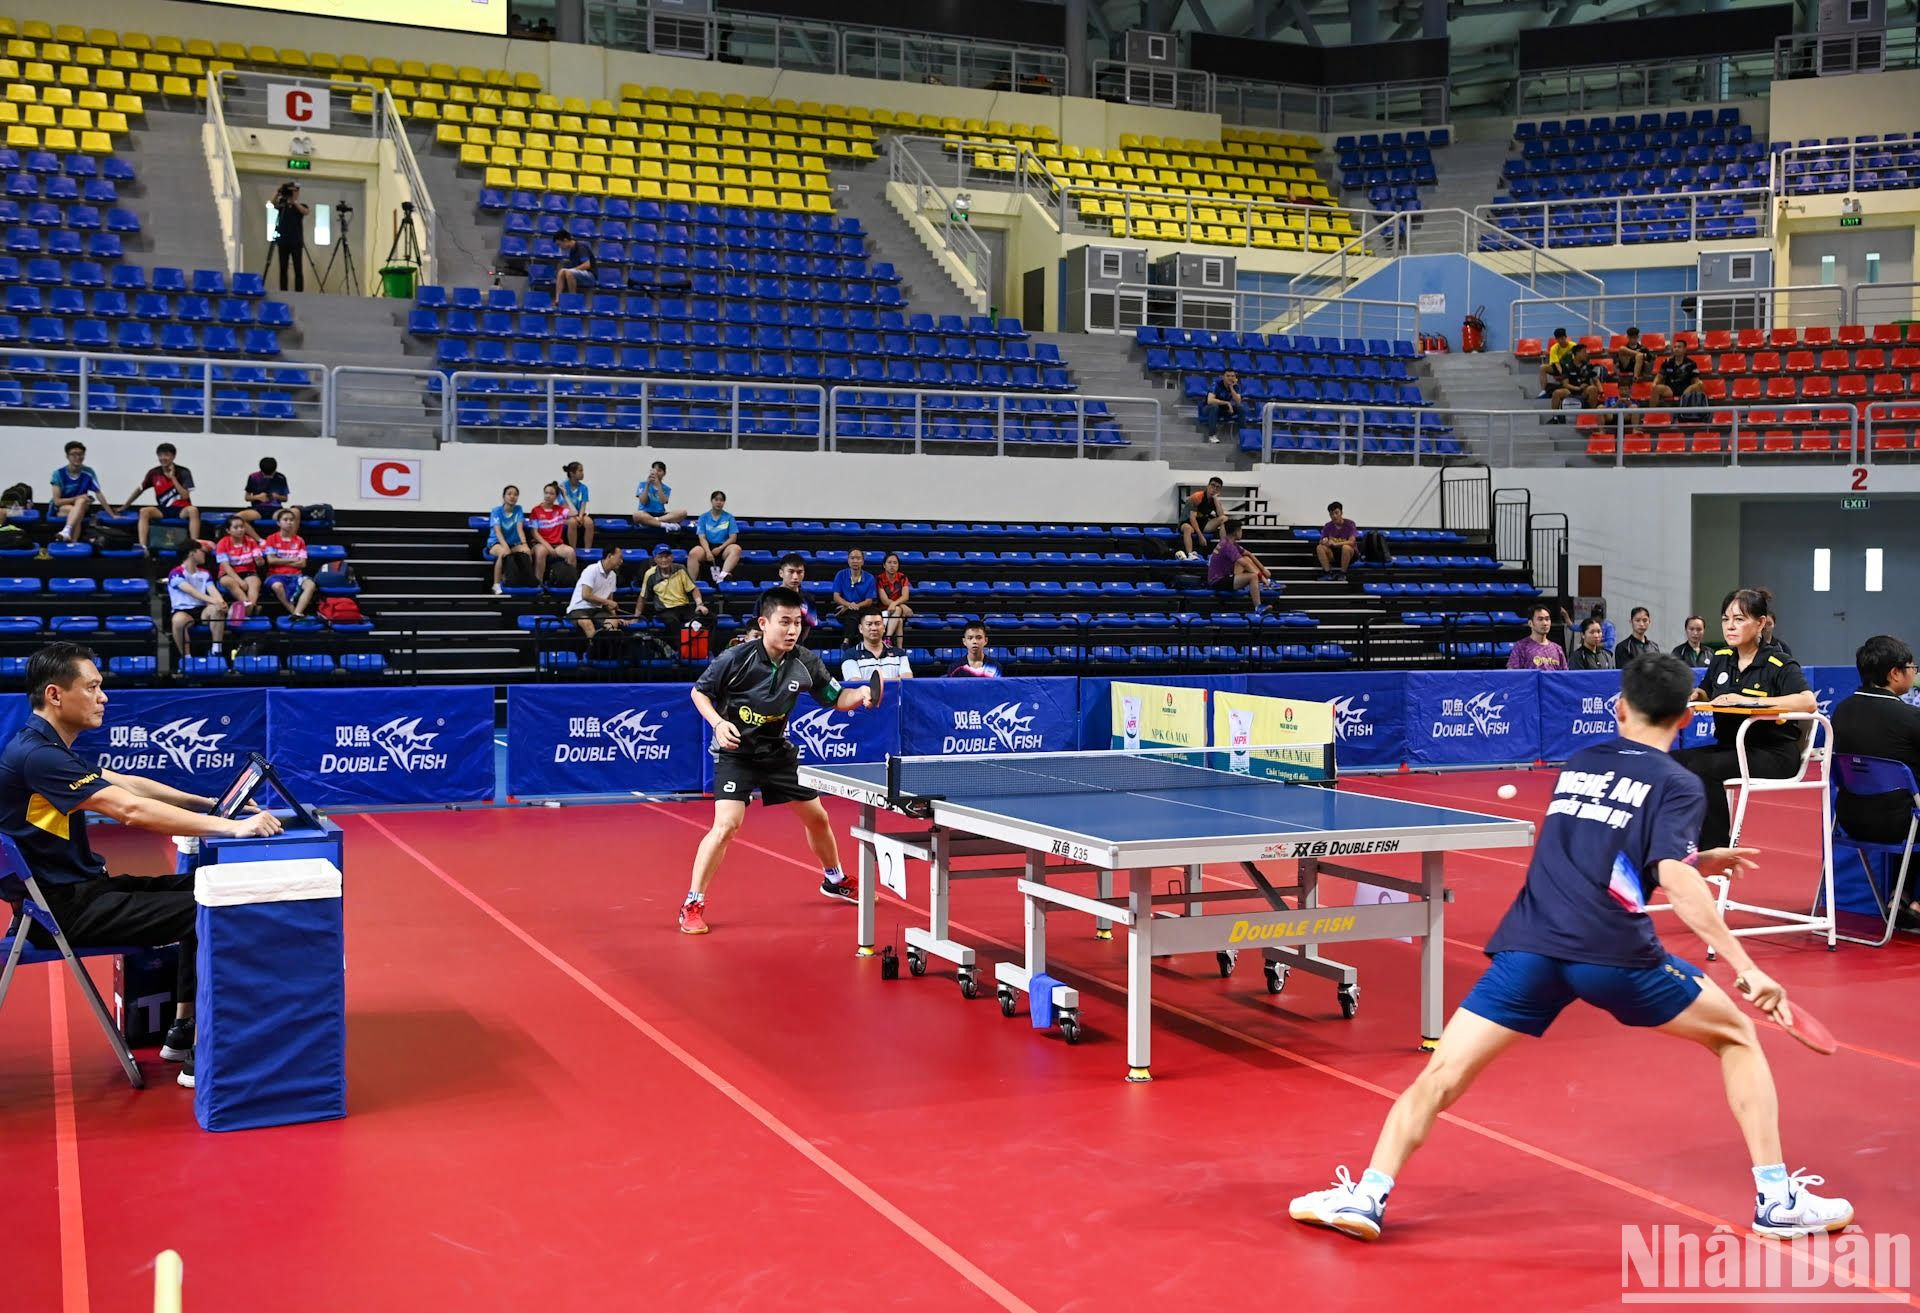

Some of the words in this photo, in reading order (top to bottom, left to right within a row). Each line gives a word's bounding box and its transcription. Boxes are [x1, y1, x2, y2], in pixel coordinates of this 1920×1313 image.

[286, 91, 313, 122] C
[370, 462, 411, 497] C
[1852, 468, 1868, 491] 2
[1844, 499, 1867, 509] EXIT
[1347, 723, 1373, 737] FISH
[1432, 722, 1475, 738] DOUBLE
[1487, 721, 1510, 735] FISH
[1572, 719, 1615, 735] DOUBLE
[943, 736, 997, 754] DOUBLE
[1014, 735, 1043, 750] FISH
[1234, 736, 1247, 745] NPK
[554, 744, 617, 763] DOUBLE
[636, 744, 670, 760] FISH
[825, 743, 857, 758] FISH
[97, 752, 169, 771] DOUBLE
[196, 752, 235, 768] FISH
[320, 754, 389, 773] DOUBLE
[410, 754, 447, 770] FISH
[1608, 777, 1652, 808] AN
[1052, 840, 1070, 858] 双鱼
[1073, 846, 1088, 861] 235
[1291, 841, 1328, 858] 双鱼
[1329, 841, 1376, 856] DOUBLE
[1375, 839, 1400, 853] FISH
[1228, 920, 1310, 943] DOUBLE
[1312, 915, 1356, 935] FISH
